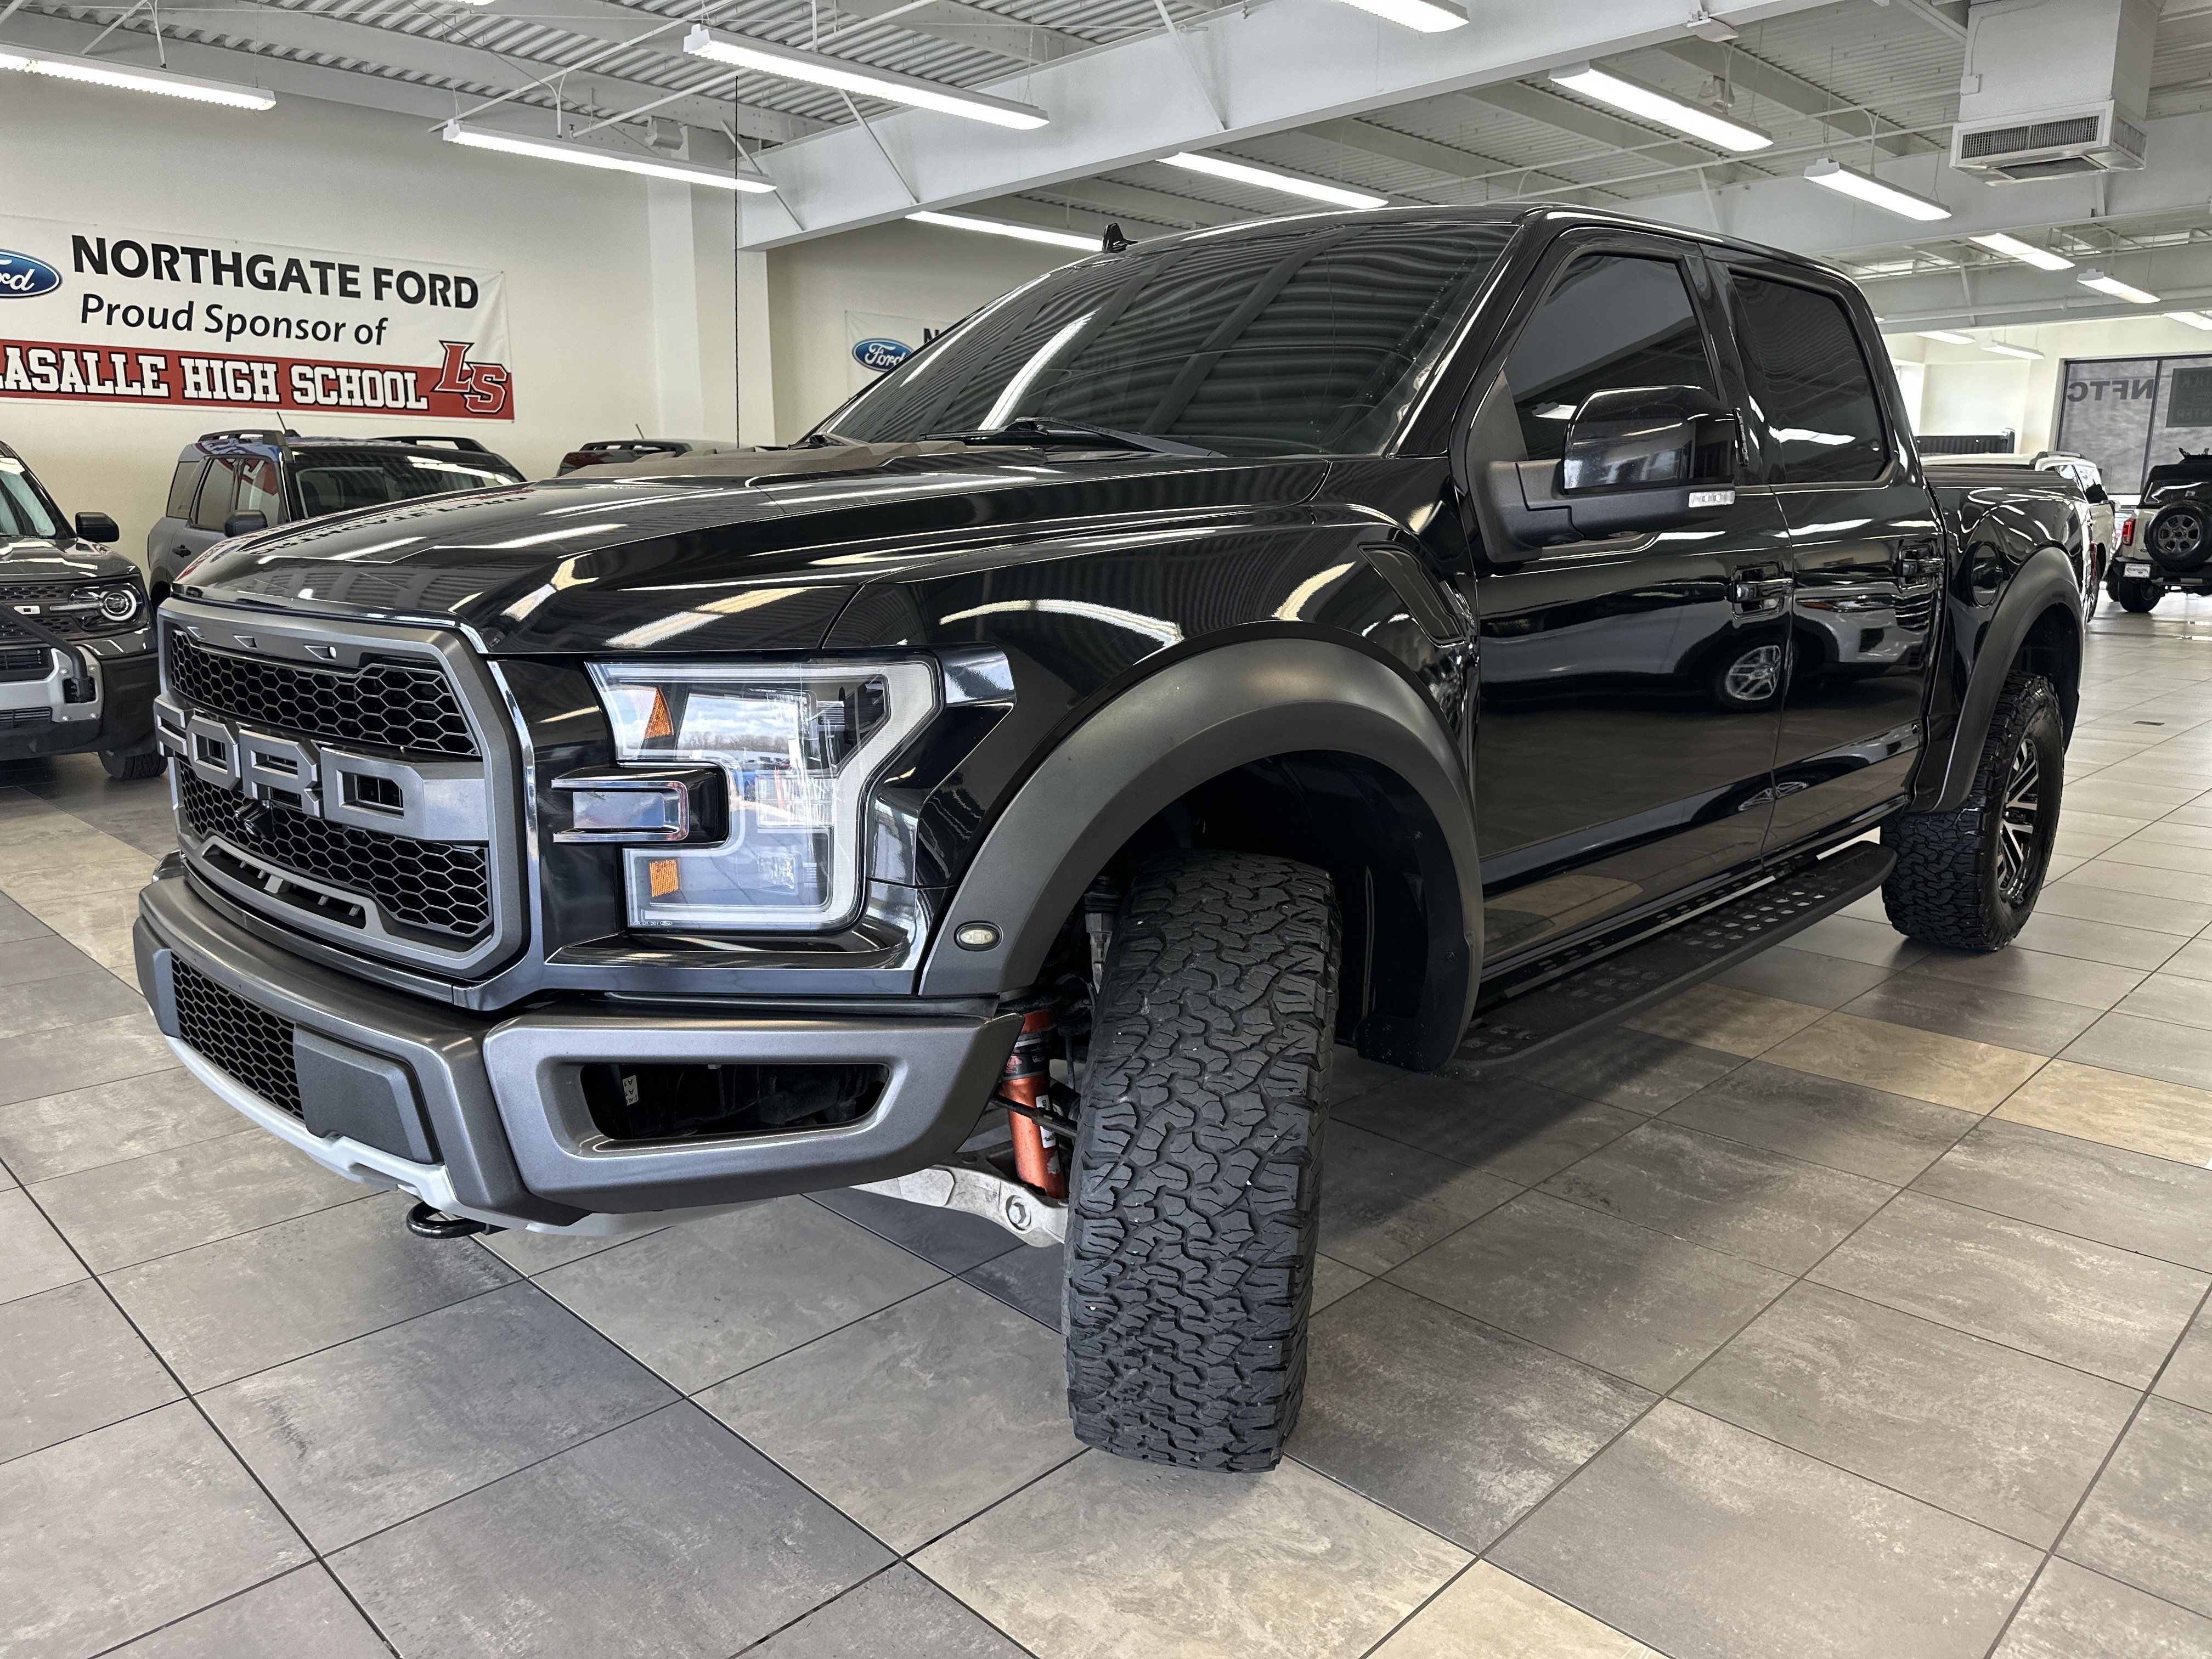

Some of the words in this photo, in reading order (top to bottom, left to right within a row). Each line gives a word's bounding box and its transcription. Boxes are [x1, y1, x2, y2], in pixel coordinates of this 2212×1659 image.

[0, 259, 35, 291] rd
[72, 235, 361, 298] NORTHGATE
[374, 267, 478, 308] FORD
[81, 294, 194, 331] Proud
[204, 304, 346, 342] Sponsor
[354, 317, 388, 345] of
[0, 346, 170, 398] ASALLE
[179, 357, 280, 403] HIGH
[289, 364, 429, 410] SCHOOL
[154, 693, 425, 840] FORD
